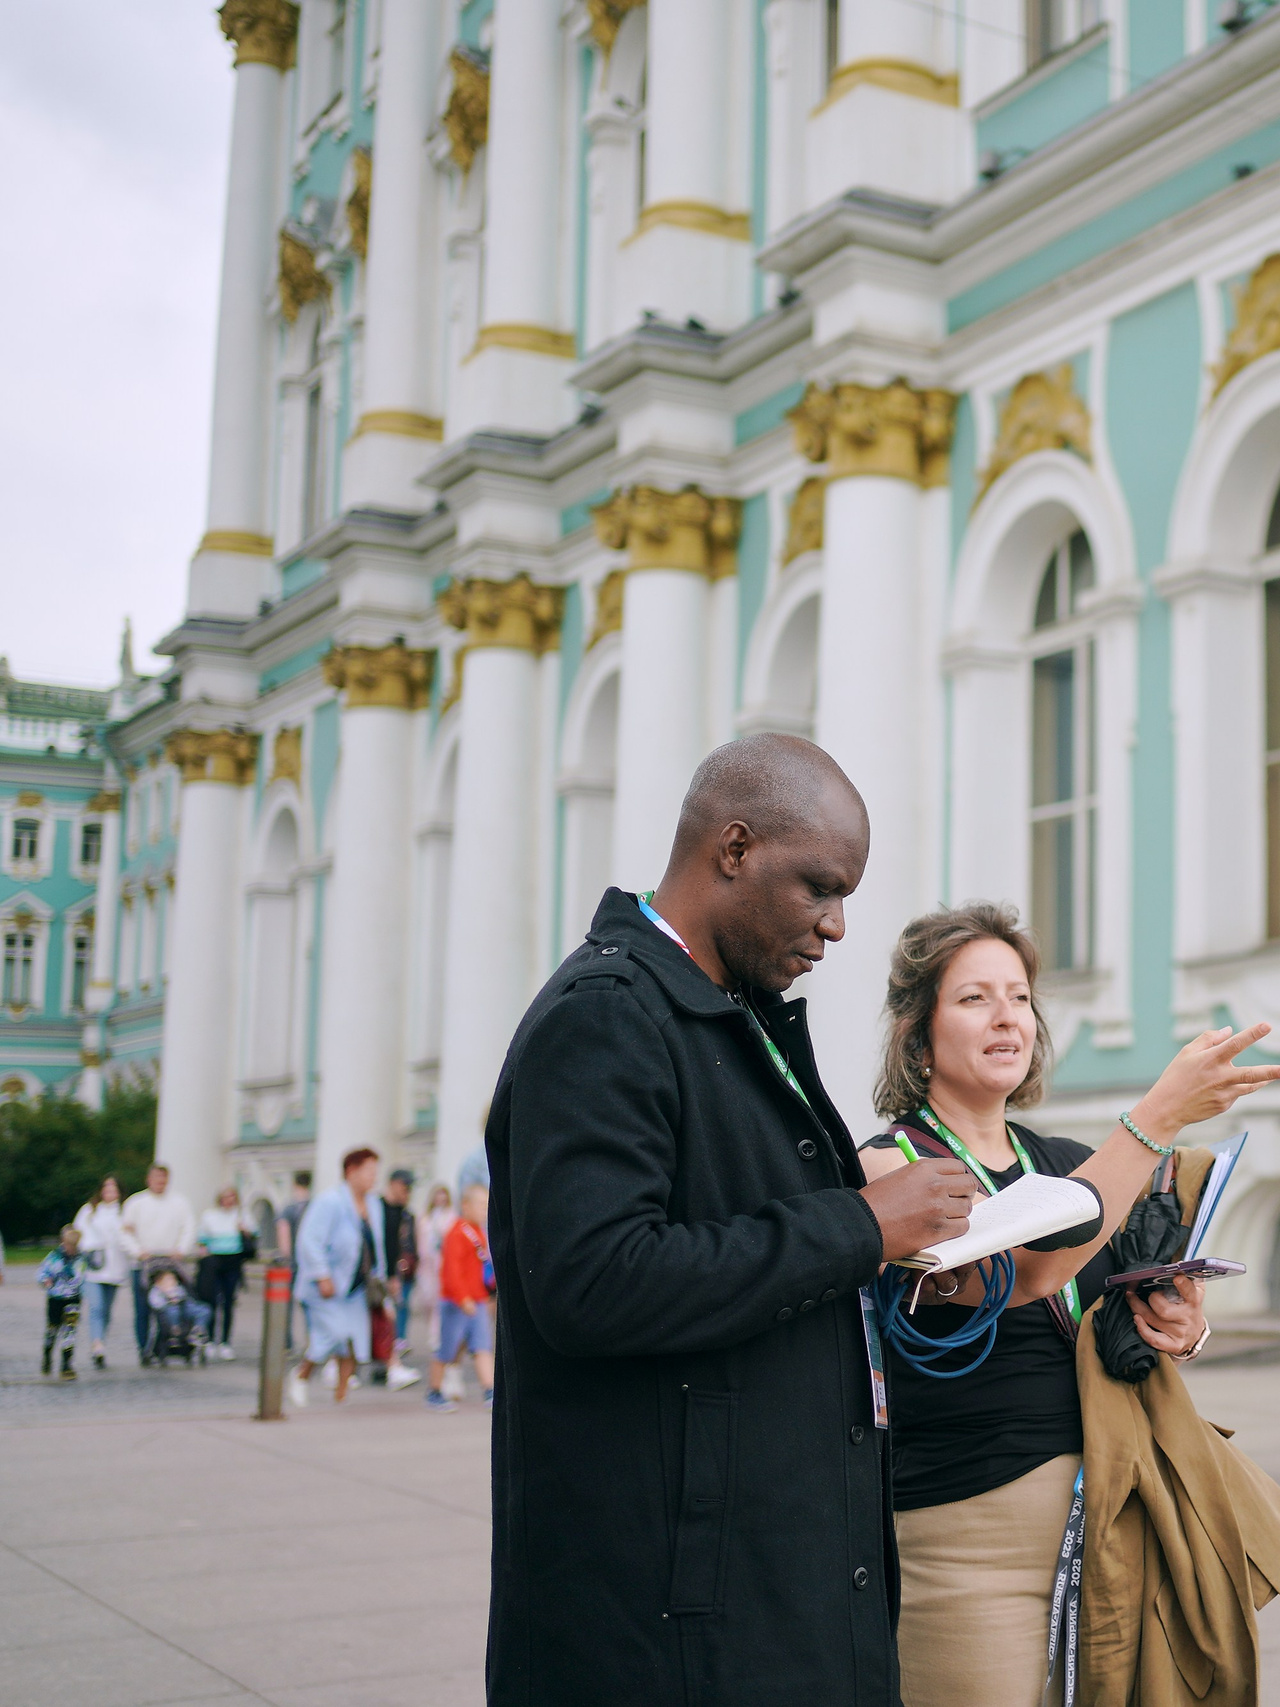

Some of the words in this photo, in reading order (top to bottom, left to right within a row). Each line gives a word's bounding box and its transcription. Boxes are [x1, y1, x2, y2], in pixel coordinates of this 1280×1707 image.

[946, 1136, 962, 1151] 2023
[1062, 1530, 1075, 1558] 2023
[1071, 1558, 1081, 1586] 2023
